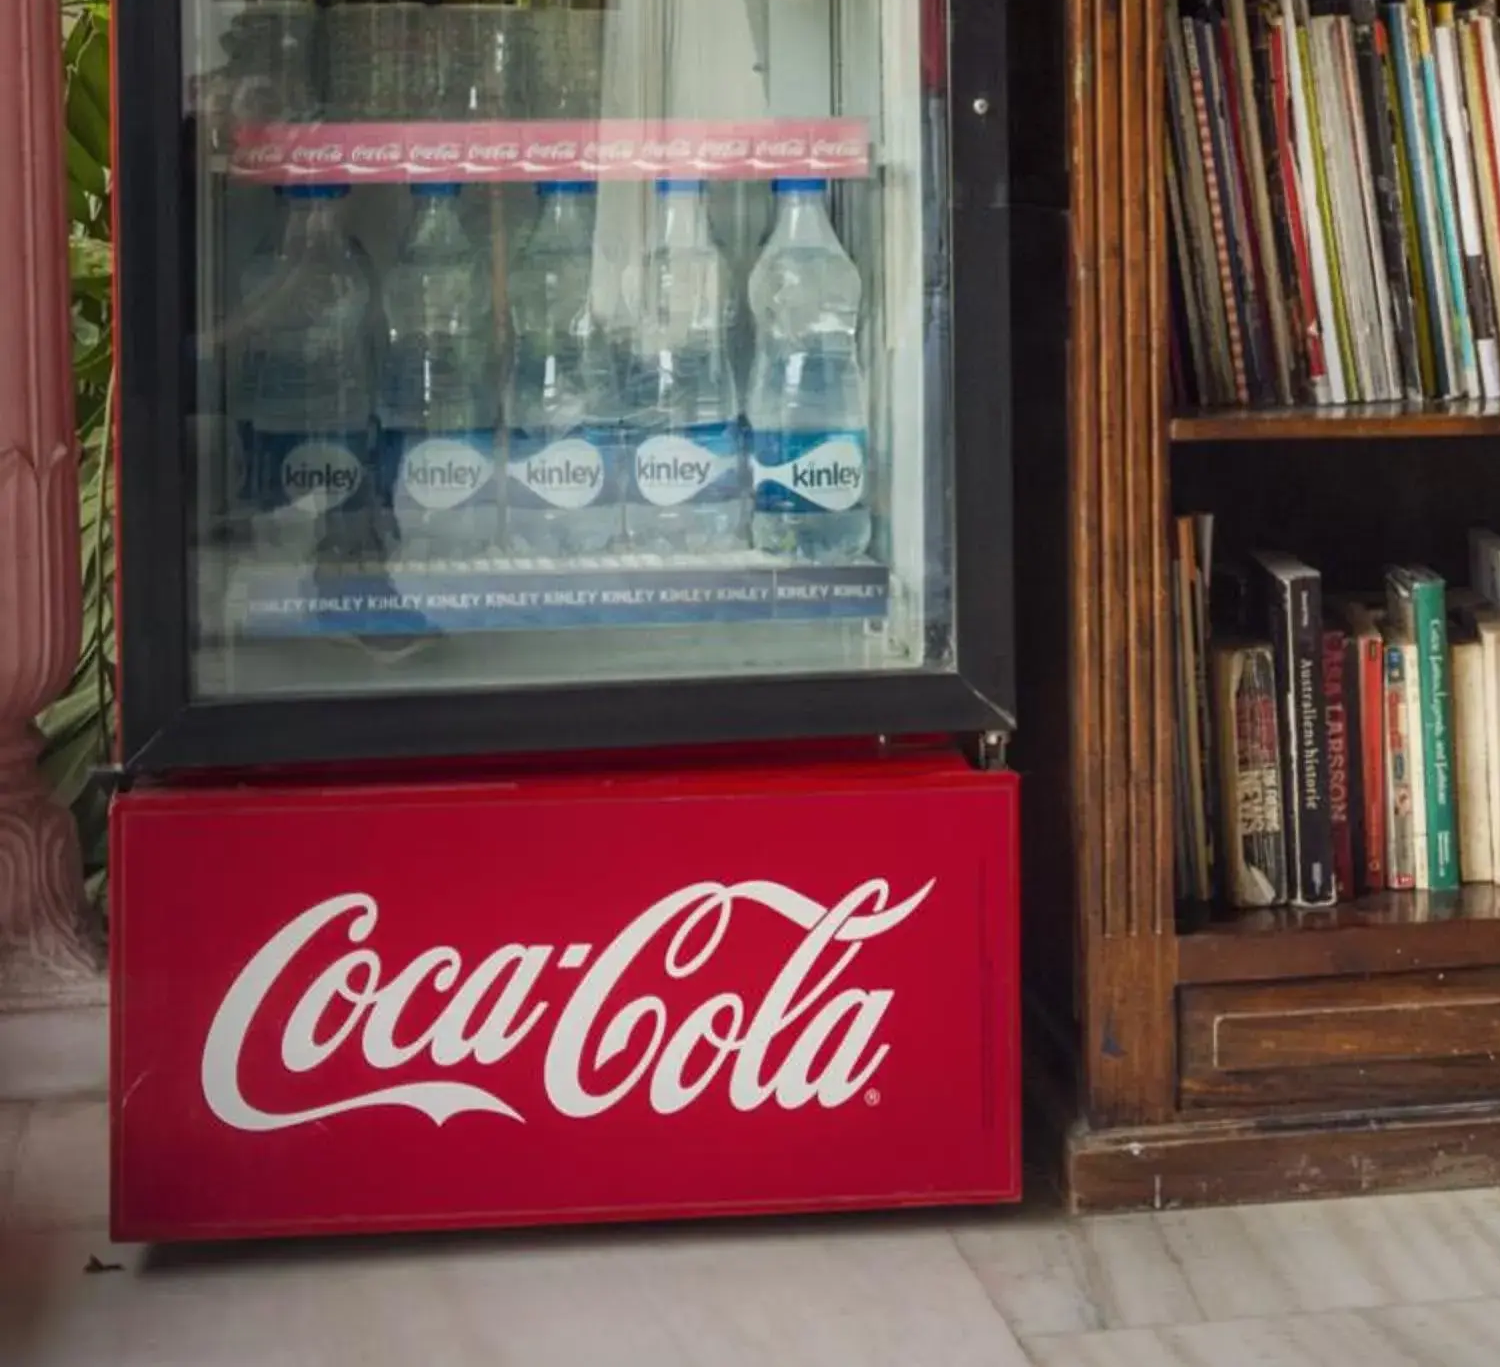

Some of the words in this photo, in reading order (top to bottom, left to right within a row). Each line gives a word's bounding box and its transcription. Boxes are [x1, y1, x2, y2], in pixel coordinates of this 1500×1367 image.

[285, 461, 358, 494] kinley
[405, 460, 482, 494] kinley
[527, 460, 601, 493] kinley
[638, 457, 711, 489] kinley
[793, 460, 861, 494] kinley
[1325, 703, 1347, 822] LARSSON
[201, 876, 937, 1131] Coca-Cola
